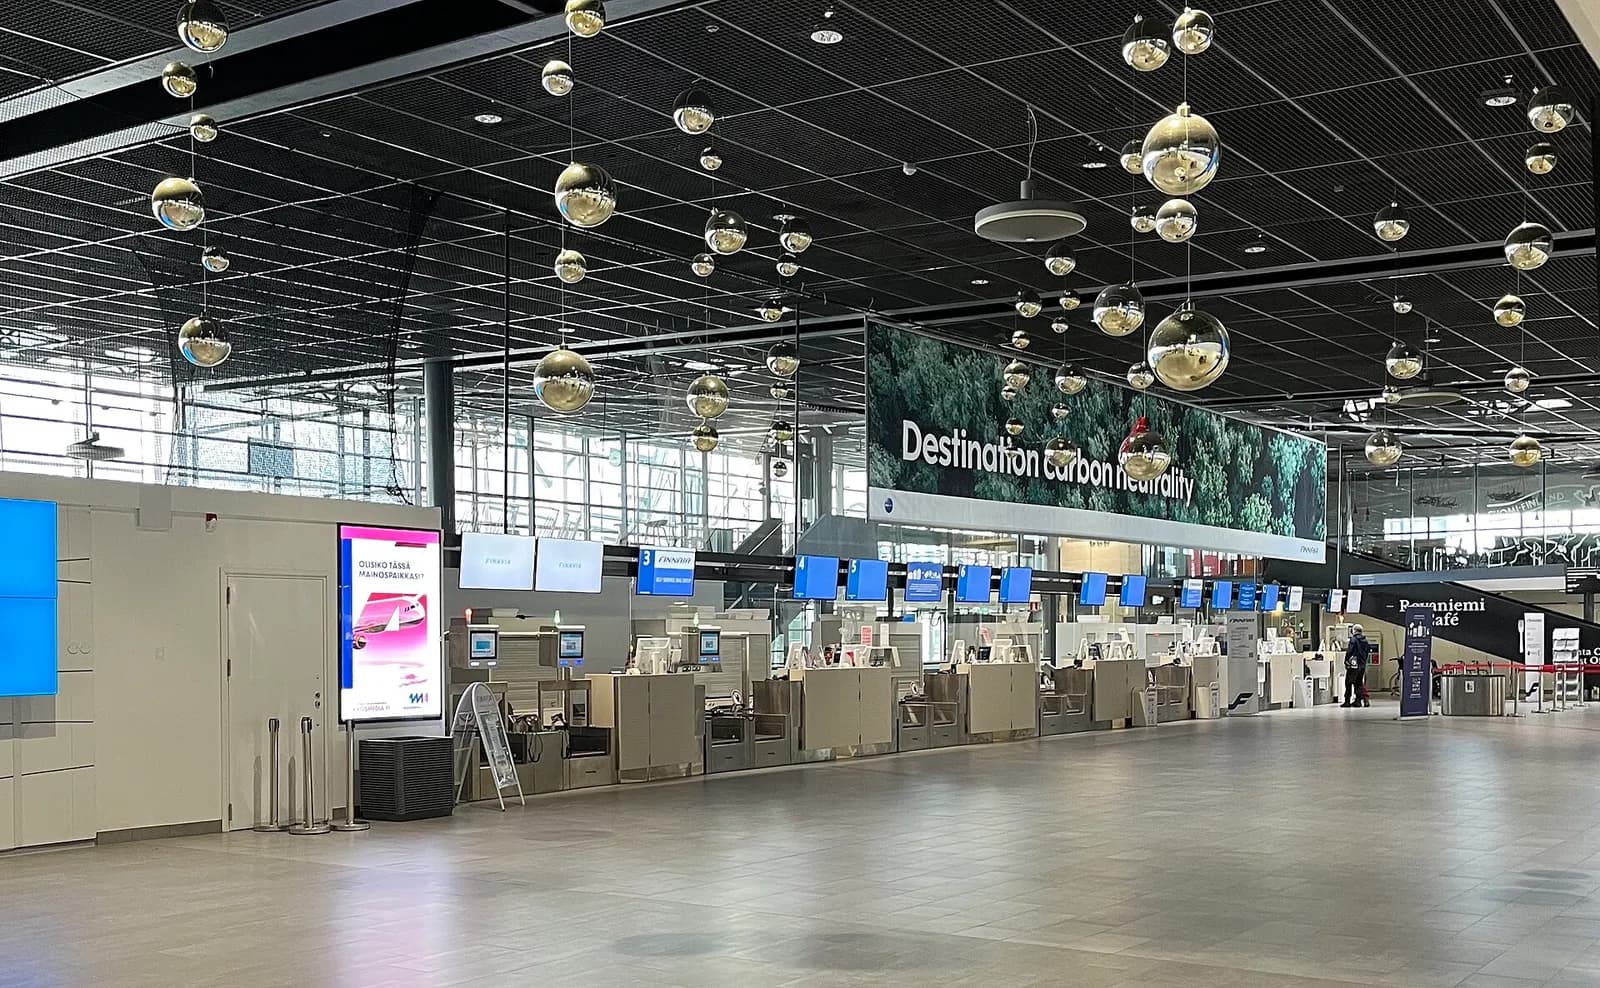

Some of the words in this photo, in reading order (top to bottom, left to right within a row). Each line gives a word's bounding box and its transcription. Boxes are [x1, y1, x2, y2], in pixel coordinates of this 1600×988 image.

[902, 419, 1039, 478] Destination
[1043, 447, 1113, 488] carbon
[643, 550, 651, 566] 3
[798, 556, 805, 570] 4
[359, 561, 388, 569] OLISIKO
[389, 561, 411, 570] TÄSSÄ
[851, 559, 857, 573] 5
[960, 565, 966, 578] 6
[1432, 612, 1459, 626] afé
